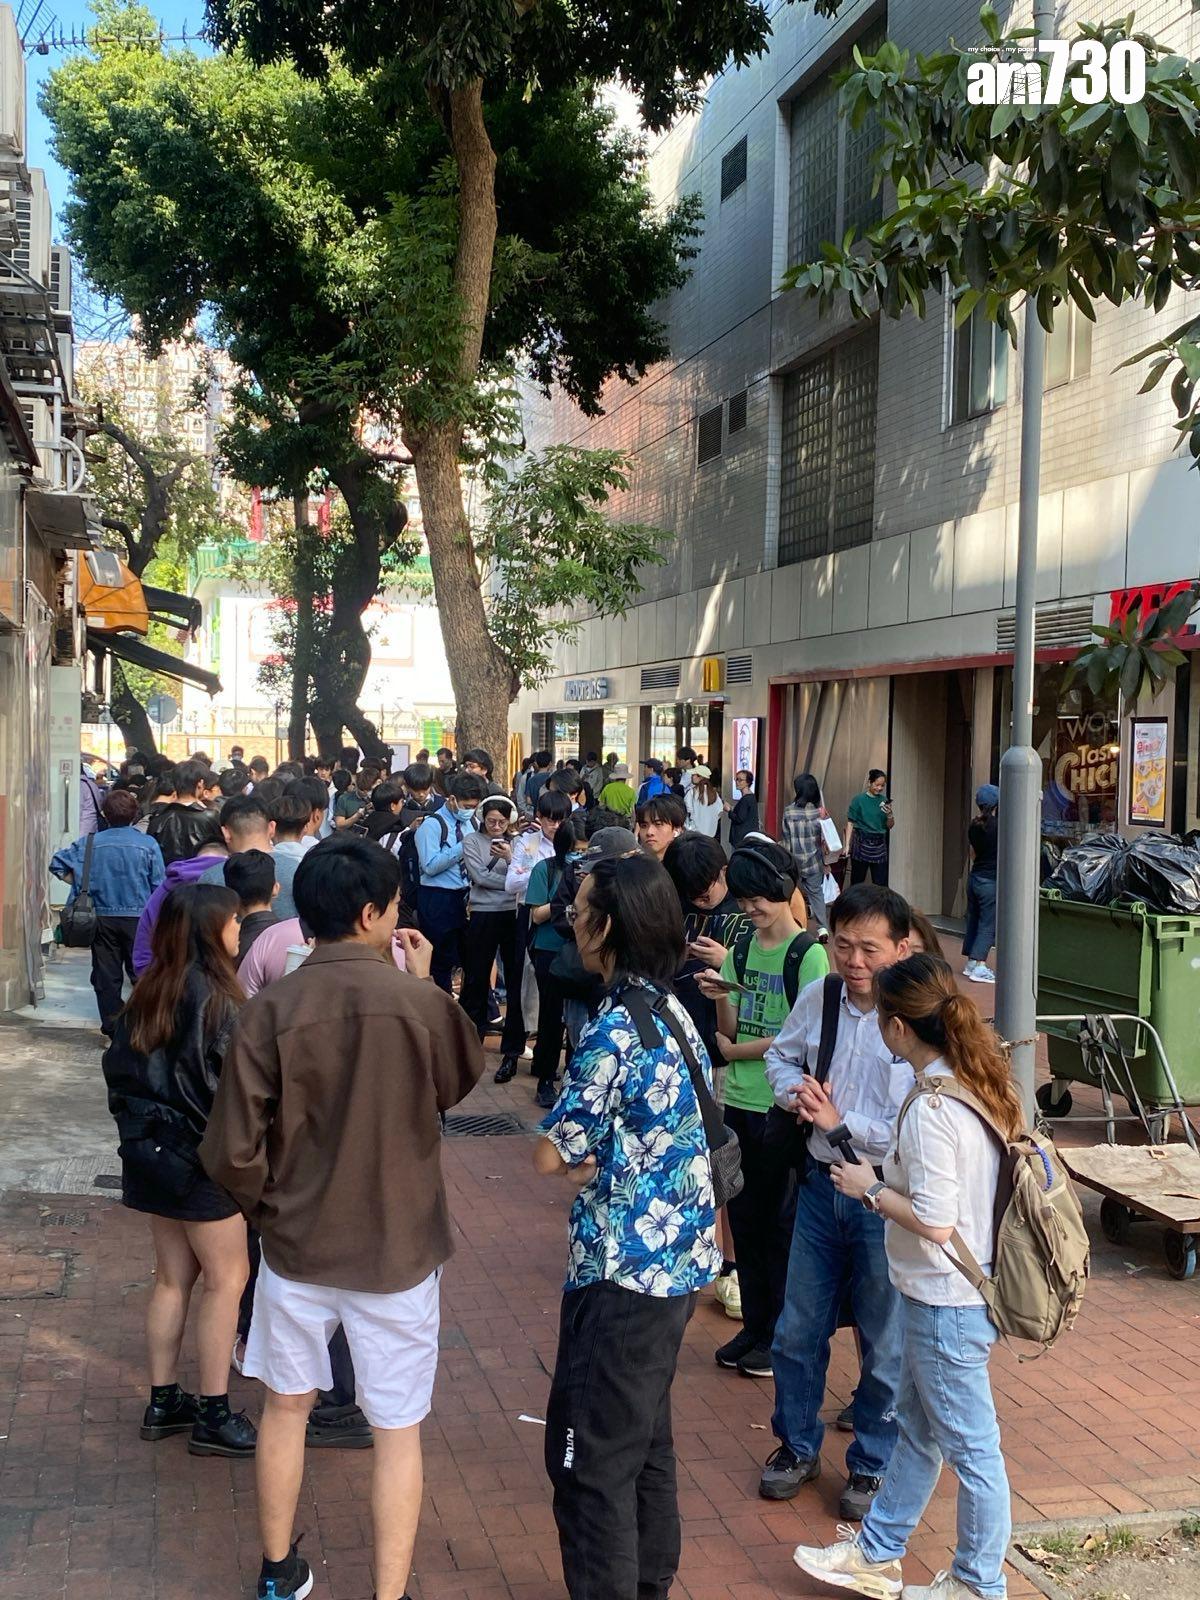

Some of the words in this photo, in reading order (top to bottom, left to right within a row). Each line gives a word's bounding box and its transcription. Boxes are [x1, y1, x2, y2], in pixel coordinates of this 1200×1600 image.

[684, 912, 752, 948] NIKE
[740, 1023, 750, 1033] IN
[750, 1026, 761, 1036] MY
[563, 1428, 574, 1468] FUTURE
